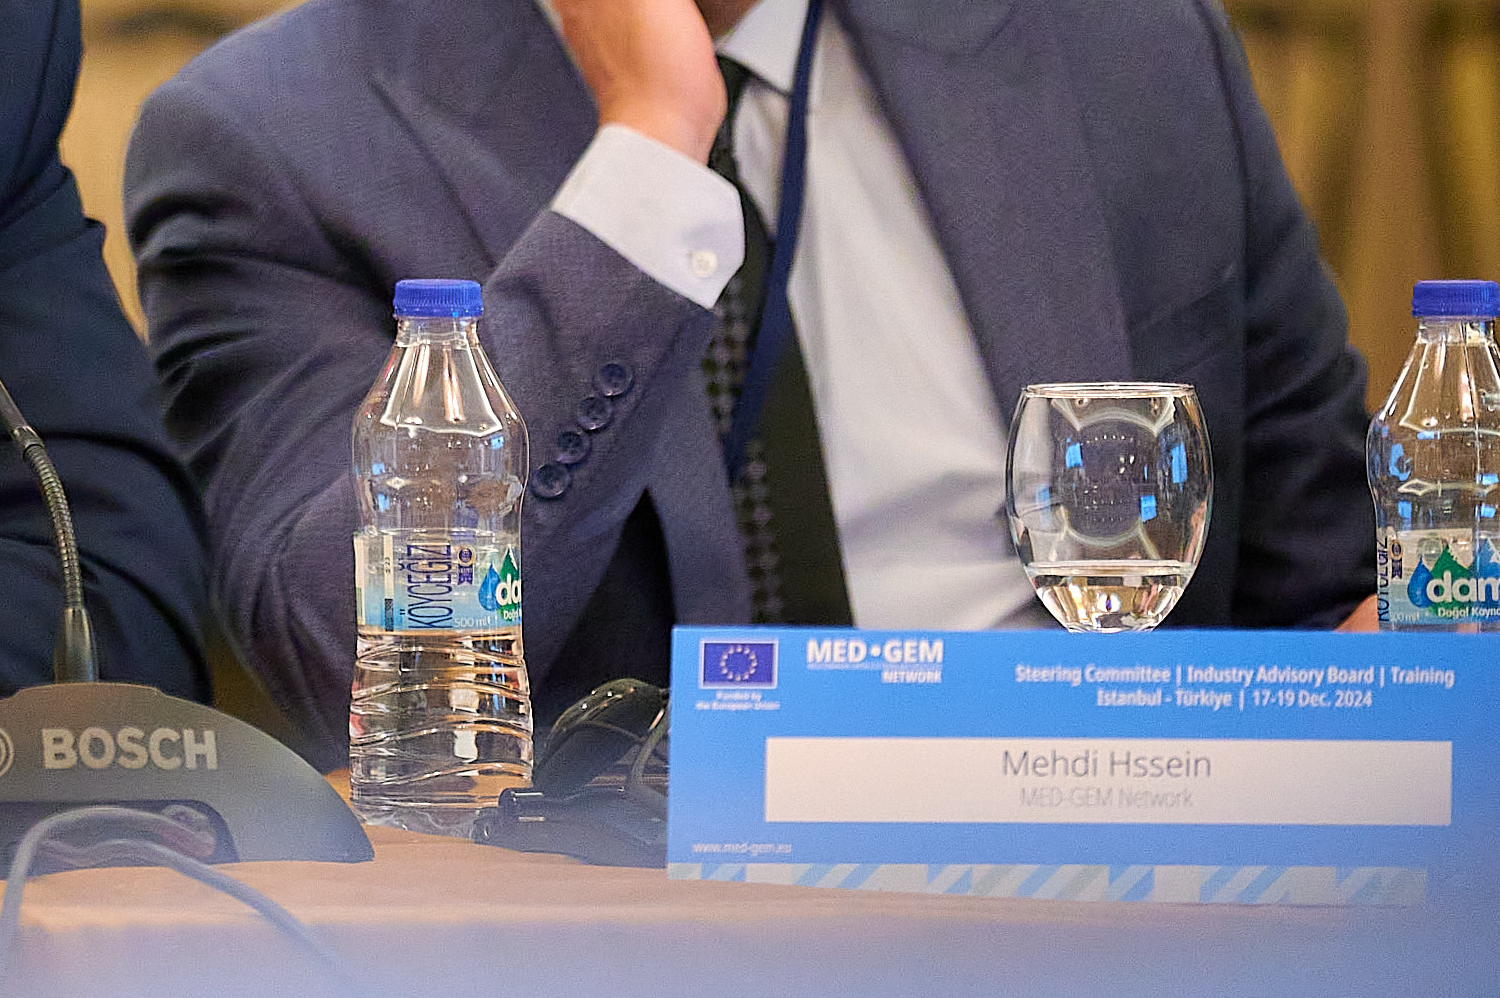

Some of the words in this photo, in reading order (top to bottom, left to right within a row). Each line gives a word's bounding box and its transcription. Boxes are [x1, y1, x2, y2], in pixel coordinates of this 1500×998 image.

[454, 617, 474, 628] 500
[882, 670, 942, 683] NETWORK
[1015, 664, 1082, 687] Steering
[1084, 664, 1171, 682] Committee
[1187, 665, 1254, 687] Industry
[1256, 665, 1324, 687] Advisory
[1327, 665, 1374, 683] Board
[1391, 666, 1455, 688] Training
[1097, 689, 1162, 706] Istanbul
[1175, 688, 1232, 711] Türkiye
[1253, 689, 1295, 707] 17-19
[1298, 690, 1331, 707] Dec.
[1335, 689, 1372, 707] 2024
[42, 727, 217, 770] BOSCH
[1002, 750, 1098, 777] Mehdi
[1109, 750, 1211, 778] Hssein
[1020, 787, 1112, 807] MED-GEM
[1118, 787, 1193, 807] Network
[692, 842, 792, 856] www.med-gem.eu
